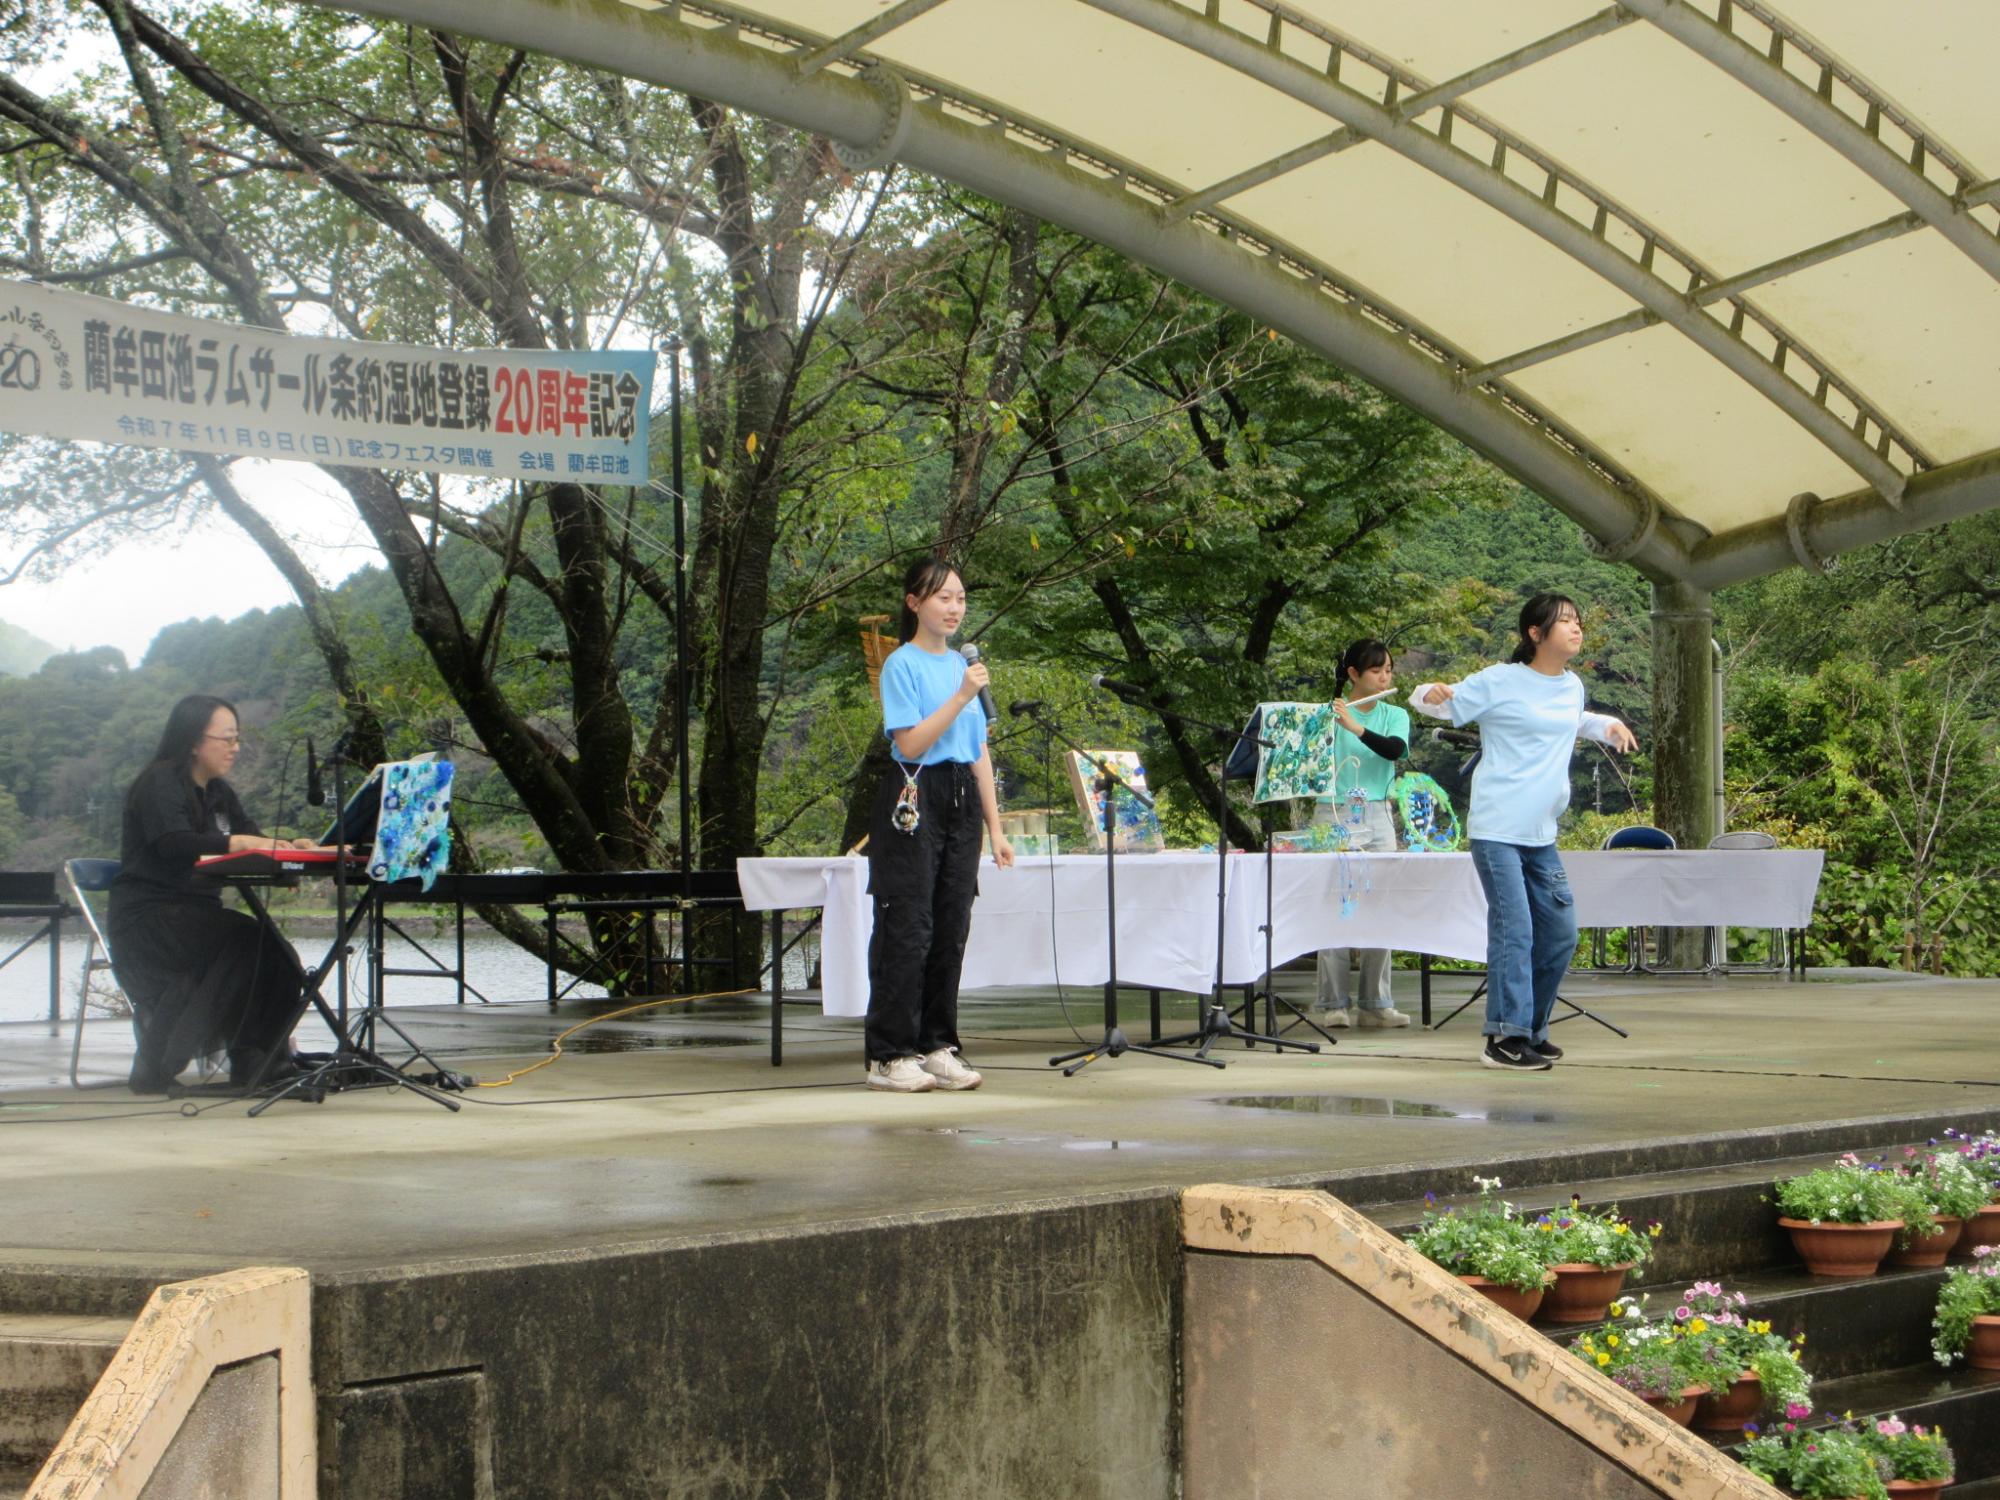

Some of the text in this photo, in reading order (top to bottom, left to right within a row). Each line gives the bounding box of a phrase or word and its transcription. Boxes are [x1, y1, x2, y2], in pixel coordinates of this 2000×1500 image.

[0, 347, 41, 391] 20
[518, 450, 556, 472] 会場
[567, 452, 631, 475] 藺牟田池
